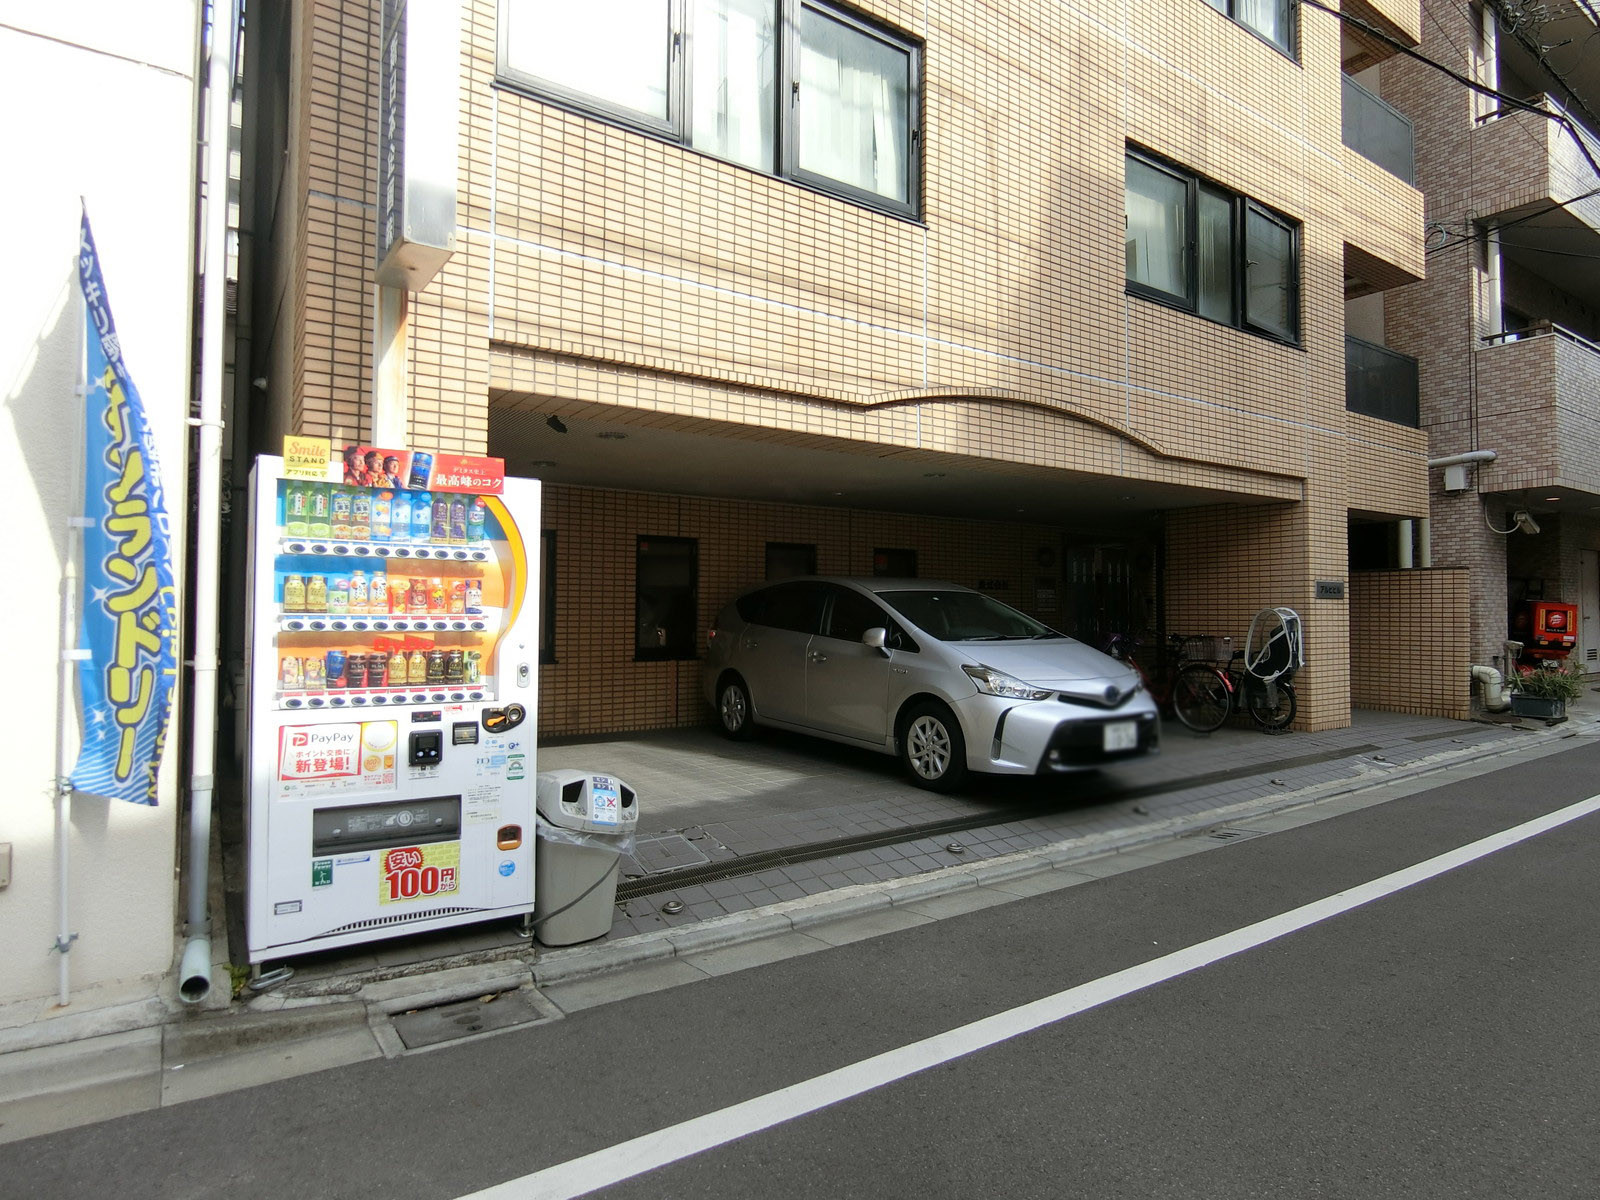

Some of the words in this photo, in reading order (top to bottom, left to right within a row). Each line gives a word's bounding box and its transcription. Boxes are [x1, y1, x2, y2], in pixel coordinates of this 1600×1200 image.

[289, 441, 326, 457] Smile
[289, 456, 326, 465] STAND
[286, 469, 318, 477] アプリ対応
[436, 474, 502, 488] 最高峰のコク
[311, 732, 354, 744] PayPay
[296, 749, 351, 758] ポイント交換に
[296, 756, 350, 773] 新登場!
[389, 852, 421, 869] 安い
[385, 867, 455, 899] 100円
[440, 881, 456, 890] から
